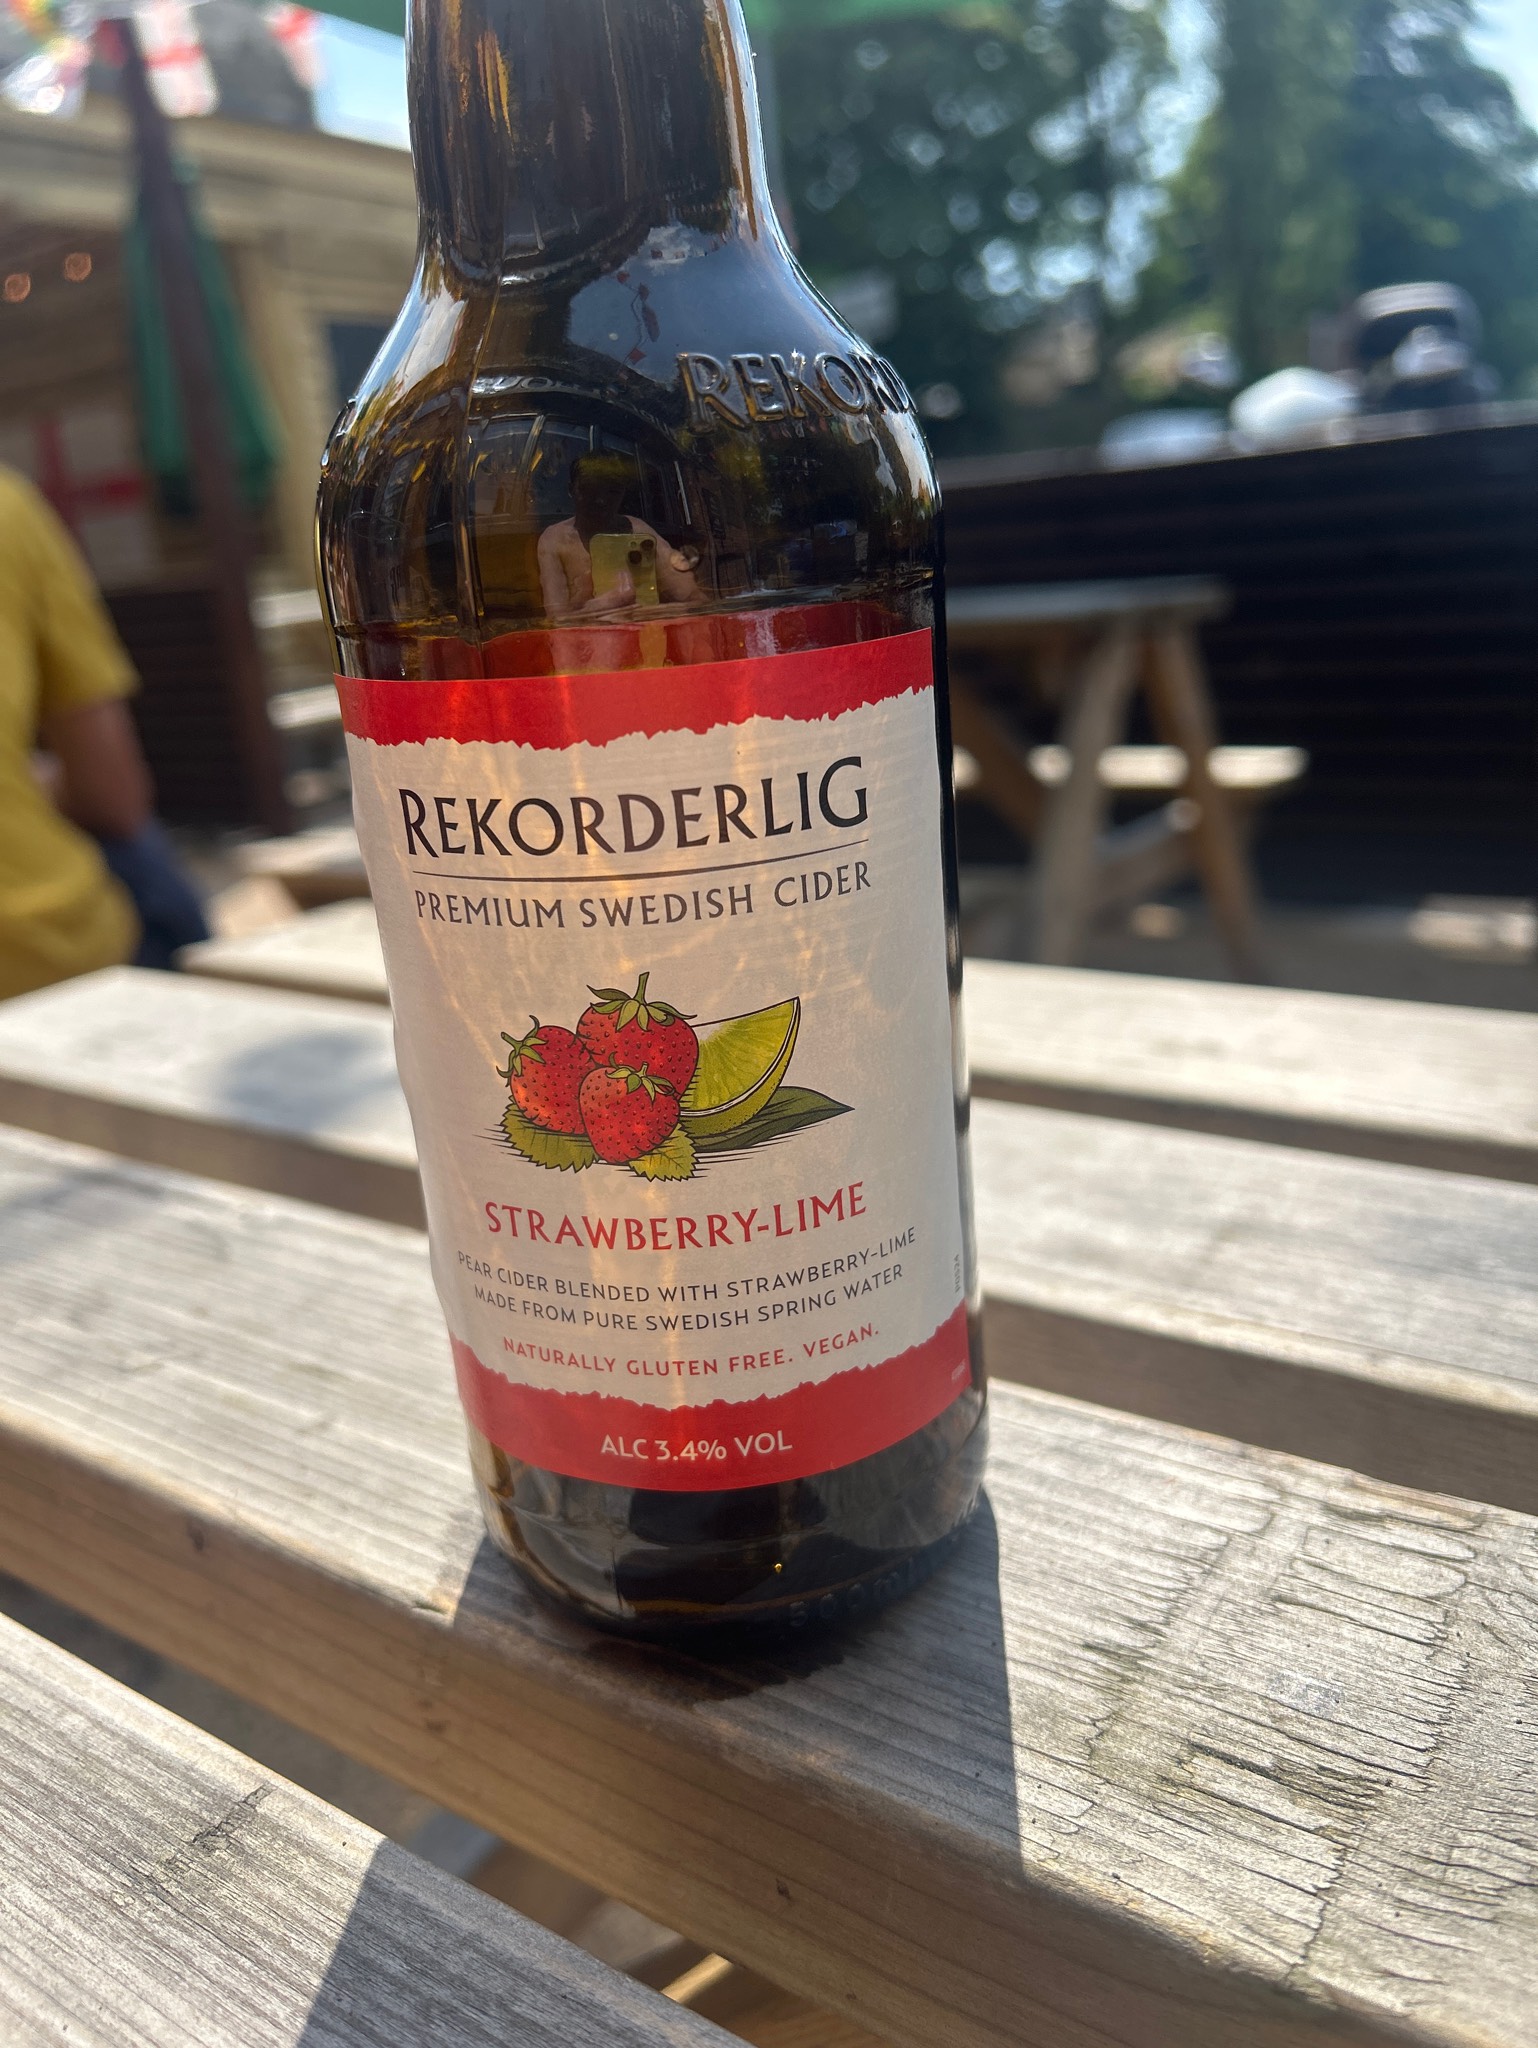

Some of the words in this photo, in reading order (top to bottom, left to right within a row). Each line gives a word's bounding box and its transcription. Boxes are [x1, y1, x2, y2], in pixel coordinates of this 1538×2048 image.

[398, 756, 869, 858] REKORDERLIG
[415, 890, 565, 928] PREMIUM
[579, 884, 754, 928] SWEDISH
[773, 861, 871, 908] CIDER
[485, 1181, 866, 1250] STRAWBERRY-LIME
[458, 1250, 492, 1279] PEAR
[497, 1267, 548, 1292] CIDER
[555, 1278, 649, 1302] BLENDED
[657, 1283, 718, 1302] WITH
[727, 1226, 916, 1297] STRAWBERRY-LIME
[474, 1284, 517, 1312] MADE
[523, 1300, 576, 1324] FROM
[584, 1310, 638, 1331] PURE
[646, 1309, 749, 1331] SWEDISH
[758, 1289, 837, 1322] SPRING
[843, 1263, 904, 1300] WATER
[503, 1336, 616, 1373] NATURALLY
[627, 1358, 718, 1376] GLUTEN
[728, 1348, 793, 1372] FREE.
[803, 1322, 879, 1358] VEGAN.
[600, 1434, 649, 1459] ALC
[654, 1439, 727, 1461] 3.4%
[734, 1430, 793, 1457] VOL
